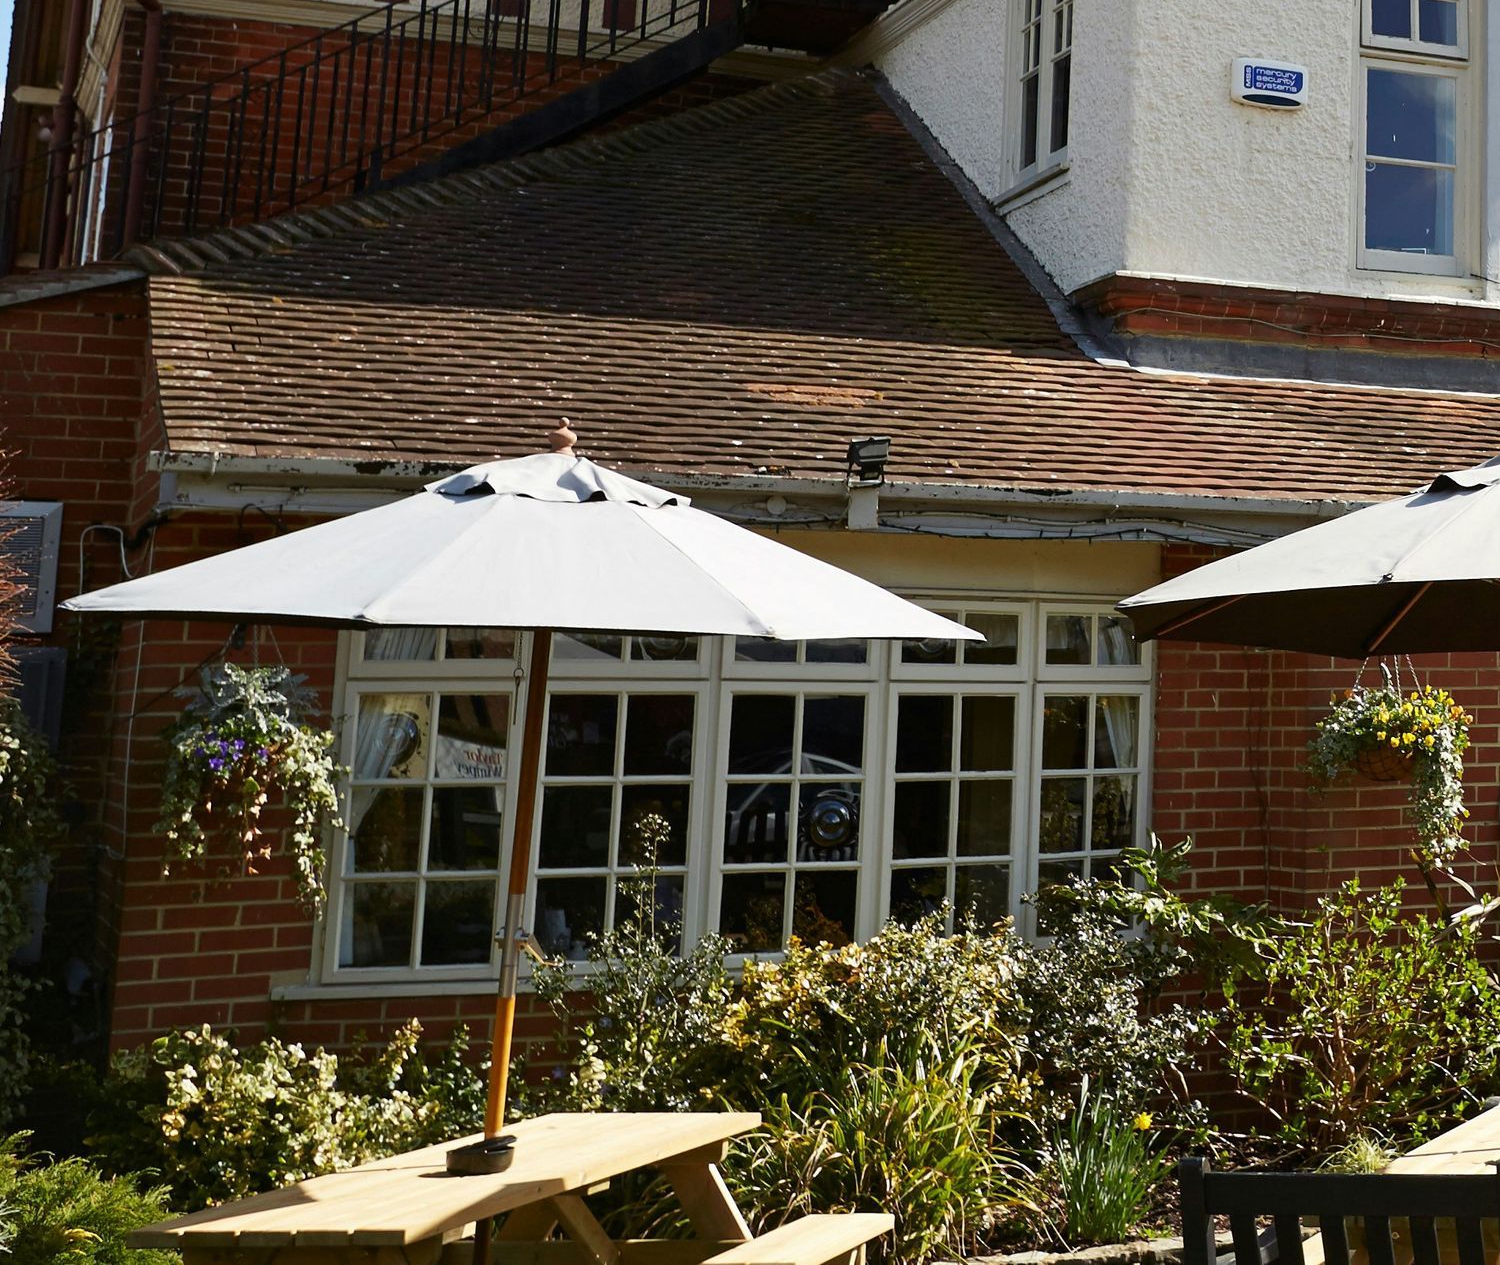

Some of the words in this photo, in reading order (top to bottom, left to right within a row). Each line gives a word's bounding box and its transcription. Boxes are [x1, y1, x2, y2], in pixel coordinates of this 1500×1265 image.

[1256, 68, 1297, 80] mercury
[1256, 75, 1296, 86] security
[1255, 81, 1297, 93] systems
